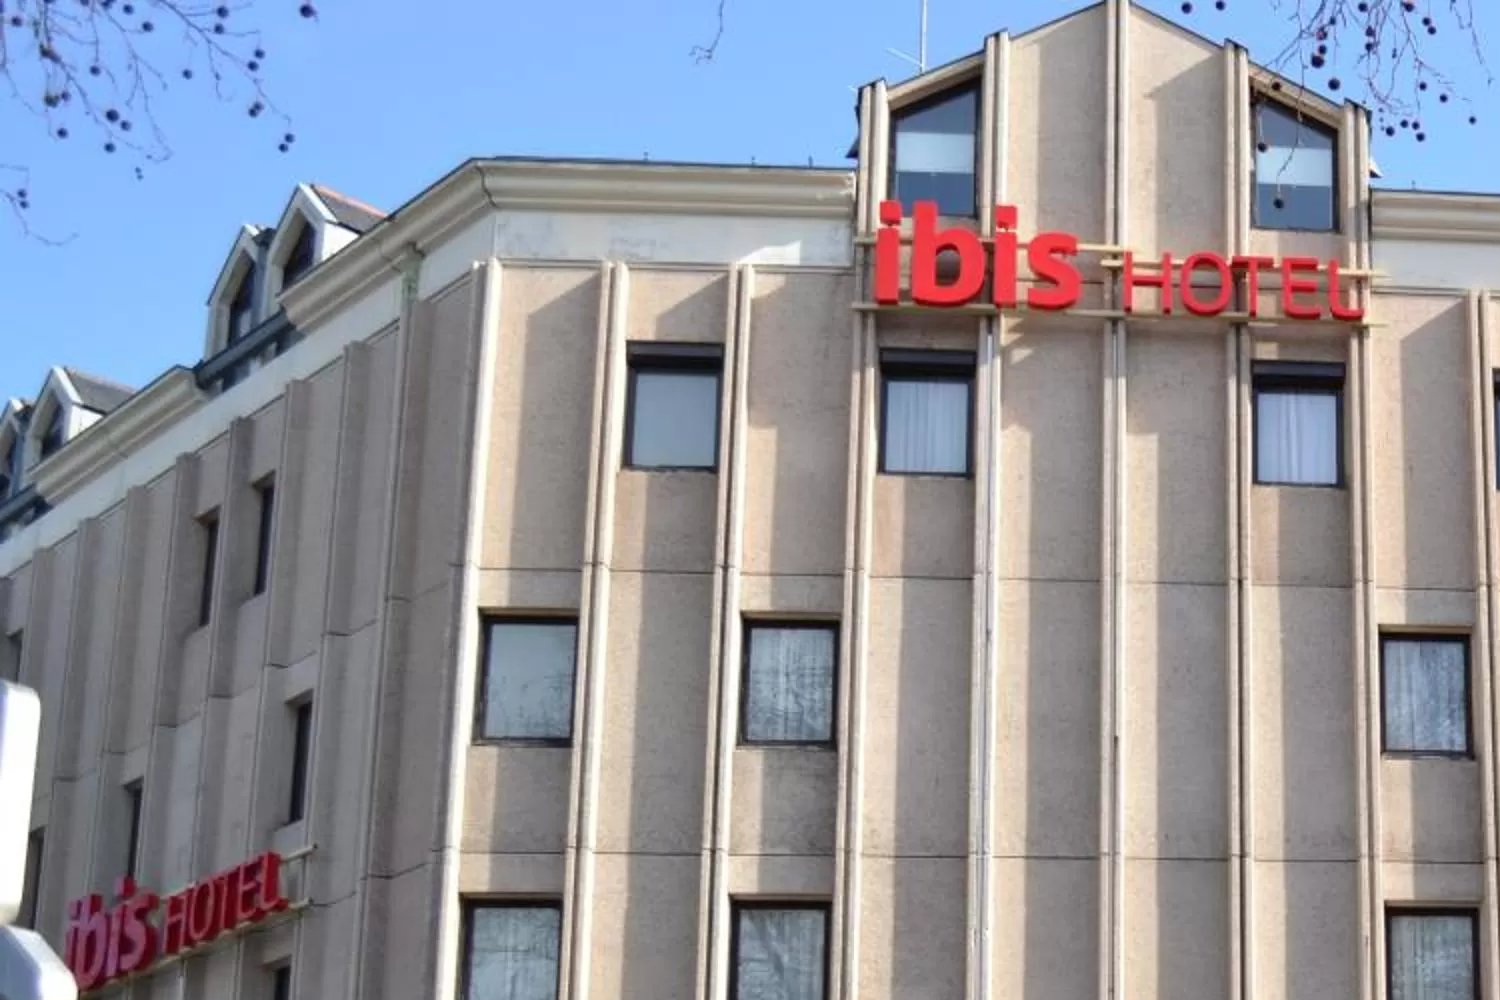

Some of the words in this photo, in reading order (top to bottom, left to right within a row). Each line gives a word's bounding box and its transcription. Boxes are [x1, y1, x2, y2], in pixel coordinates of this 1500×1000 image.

[874, 199, 1082, 310] ibis
[1123, 251, 1364, 321] HOTEL
[63, 875, 160, 992] ibis
[164, 851, 288, 955] HOTEL
